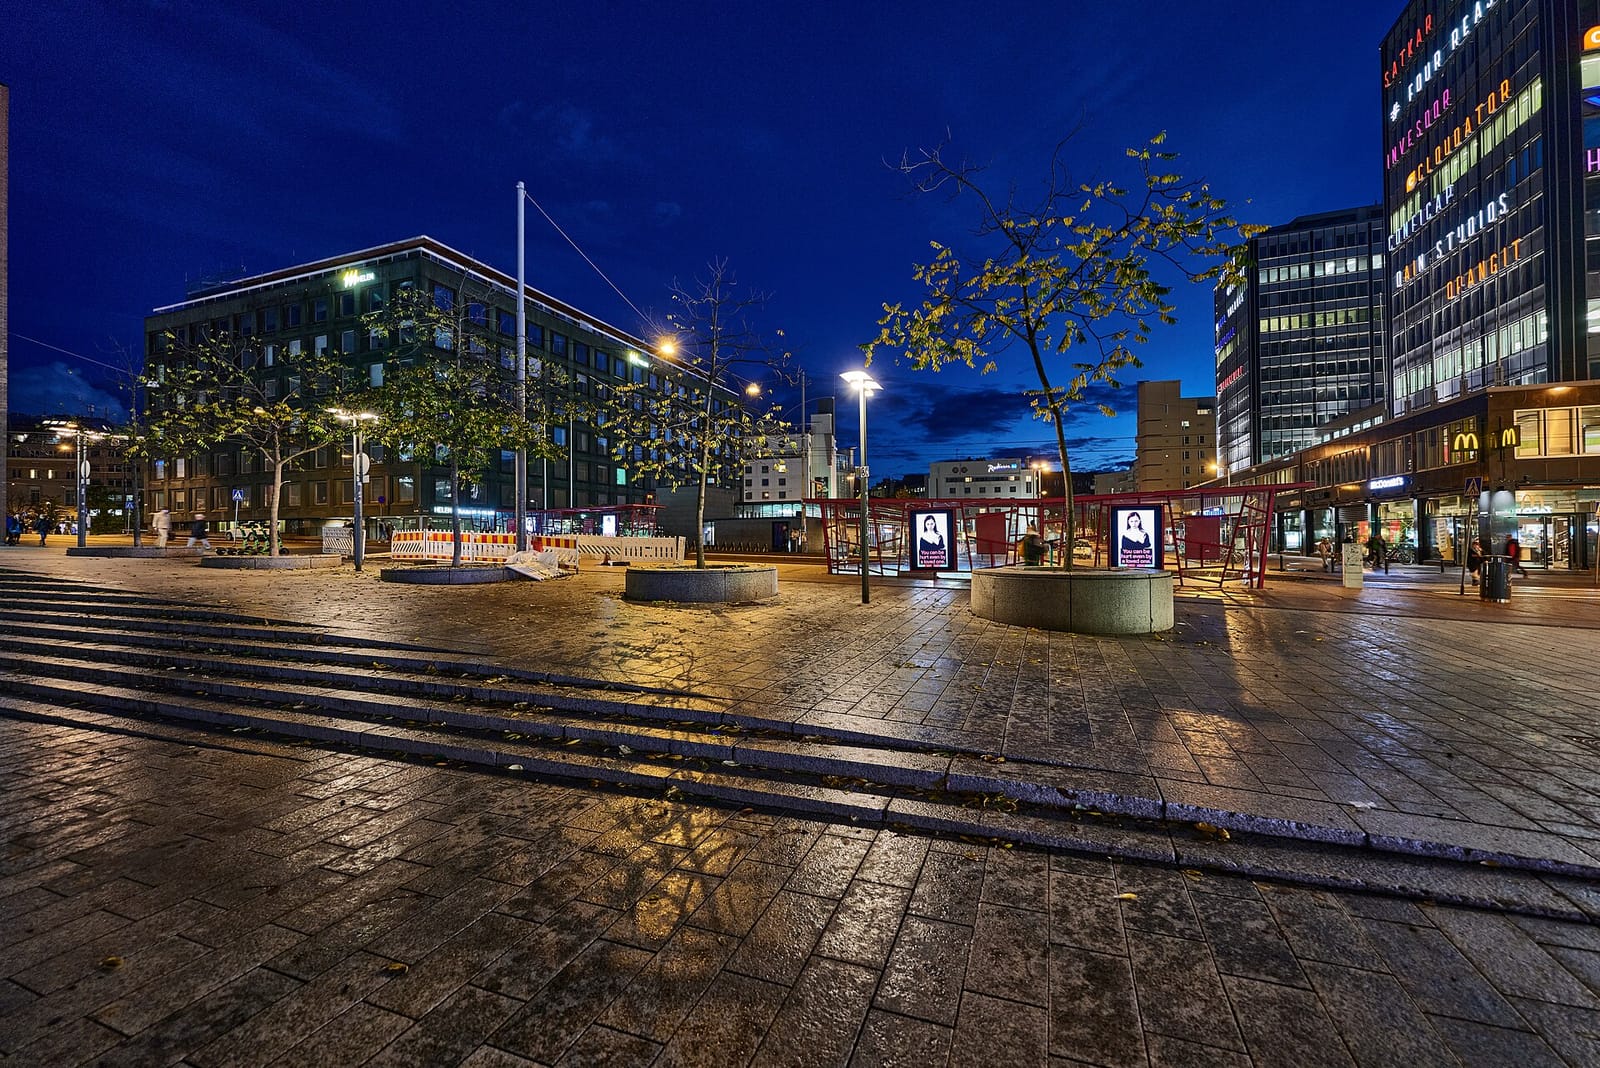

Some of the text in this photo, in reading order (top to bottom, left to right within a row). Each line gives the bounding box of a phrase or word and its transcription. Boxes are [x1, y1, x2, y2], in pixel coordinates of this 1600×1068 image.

[1384, 14, 1433, 88] SATKAR
[1407, 50, 1441, 102] FOUR
[1386, 88, 1450, 170] INVESDOR
[1417, 79, 1510, 181] CLOUDATOR
[1396, 192, 1510, 288] DAIN STUDIOS
[1446, 238, 1521, 300] ORANGIT
